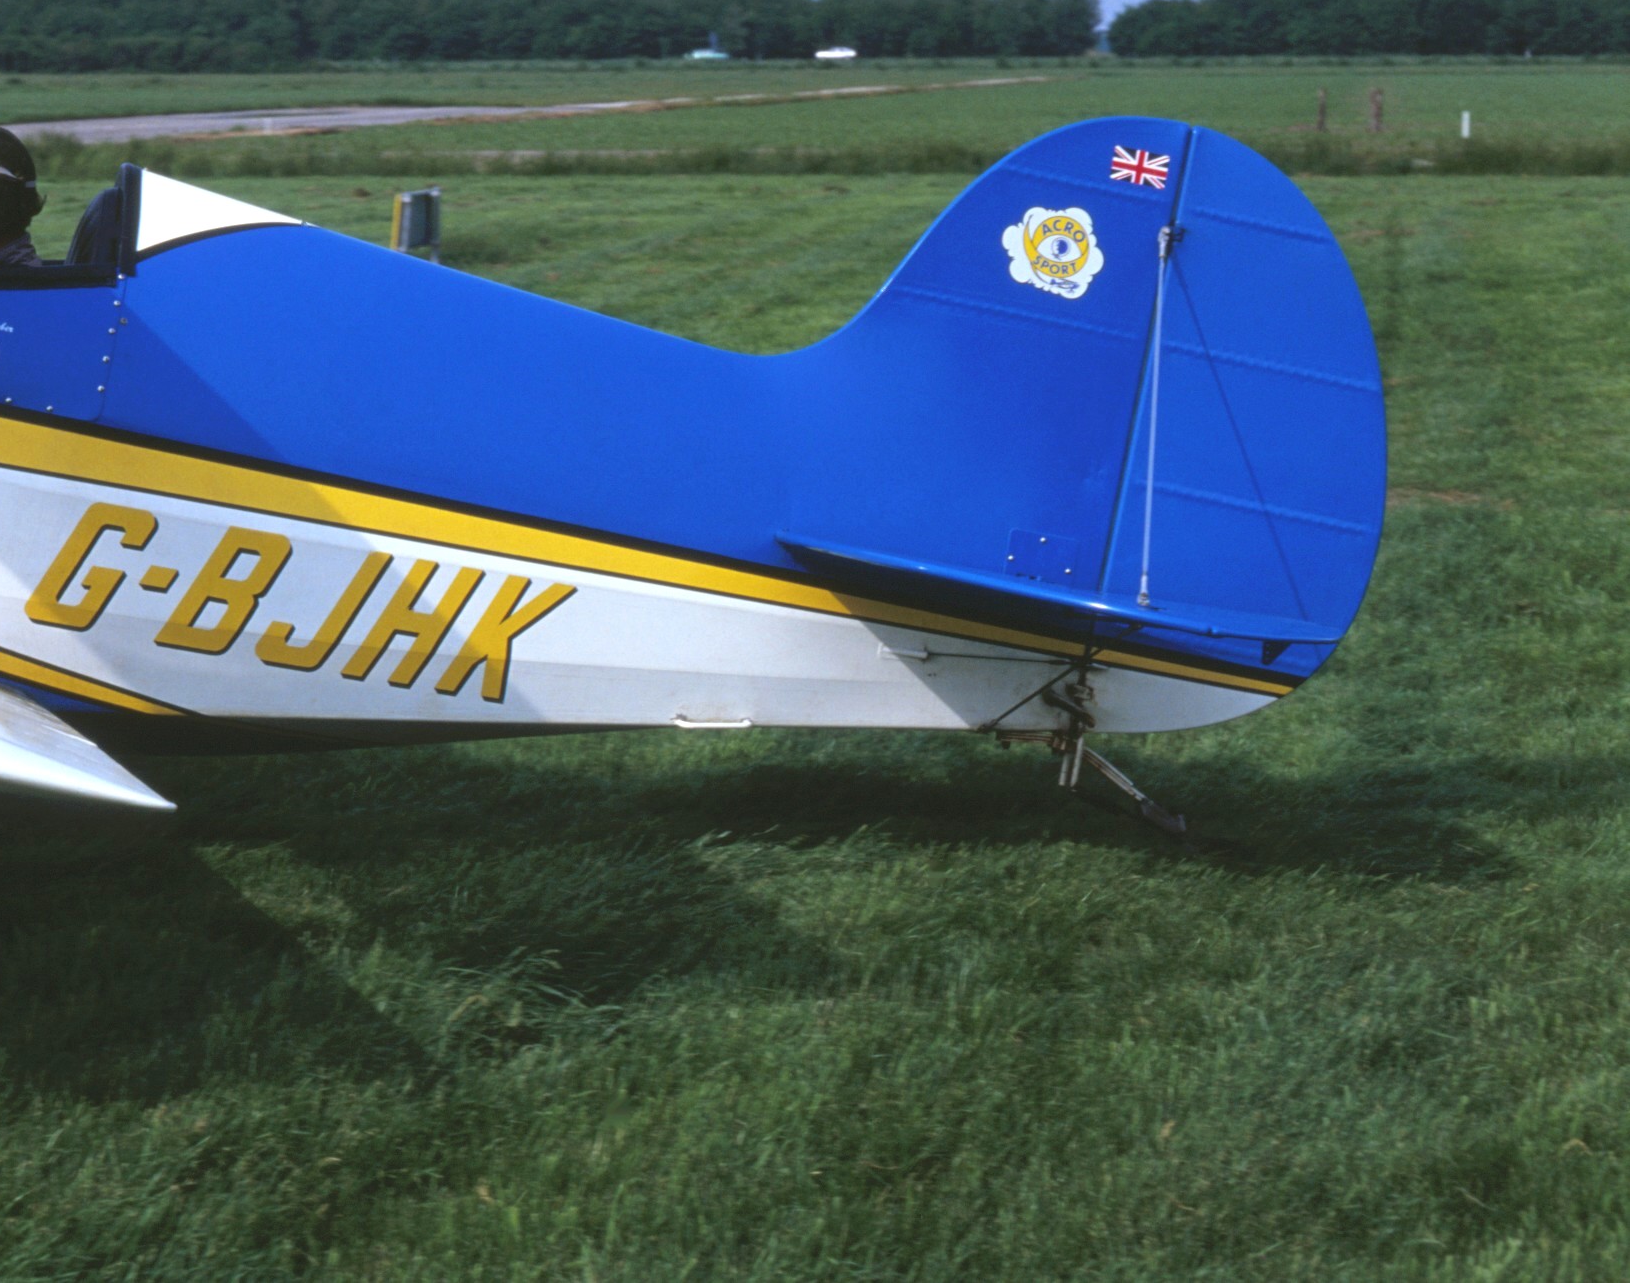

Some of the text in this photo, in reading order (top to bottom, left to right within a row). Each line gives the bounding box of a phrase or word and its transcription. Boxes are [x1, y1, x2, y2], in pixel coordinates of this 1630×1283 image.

[1041, 219, 1086, 243] ACRO
[1033, 255, 1076, 275] SPORT
[24, 502, 577, 704] G-BJHK
